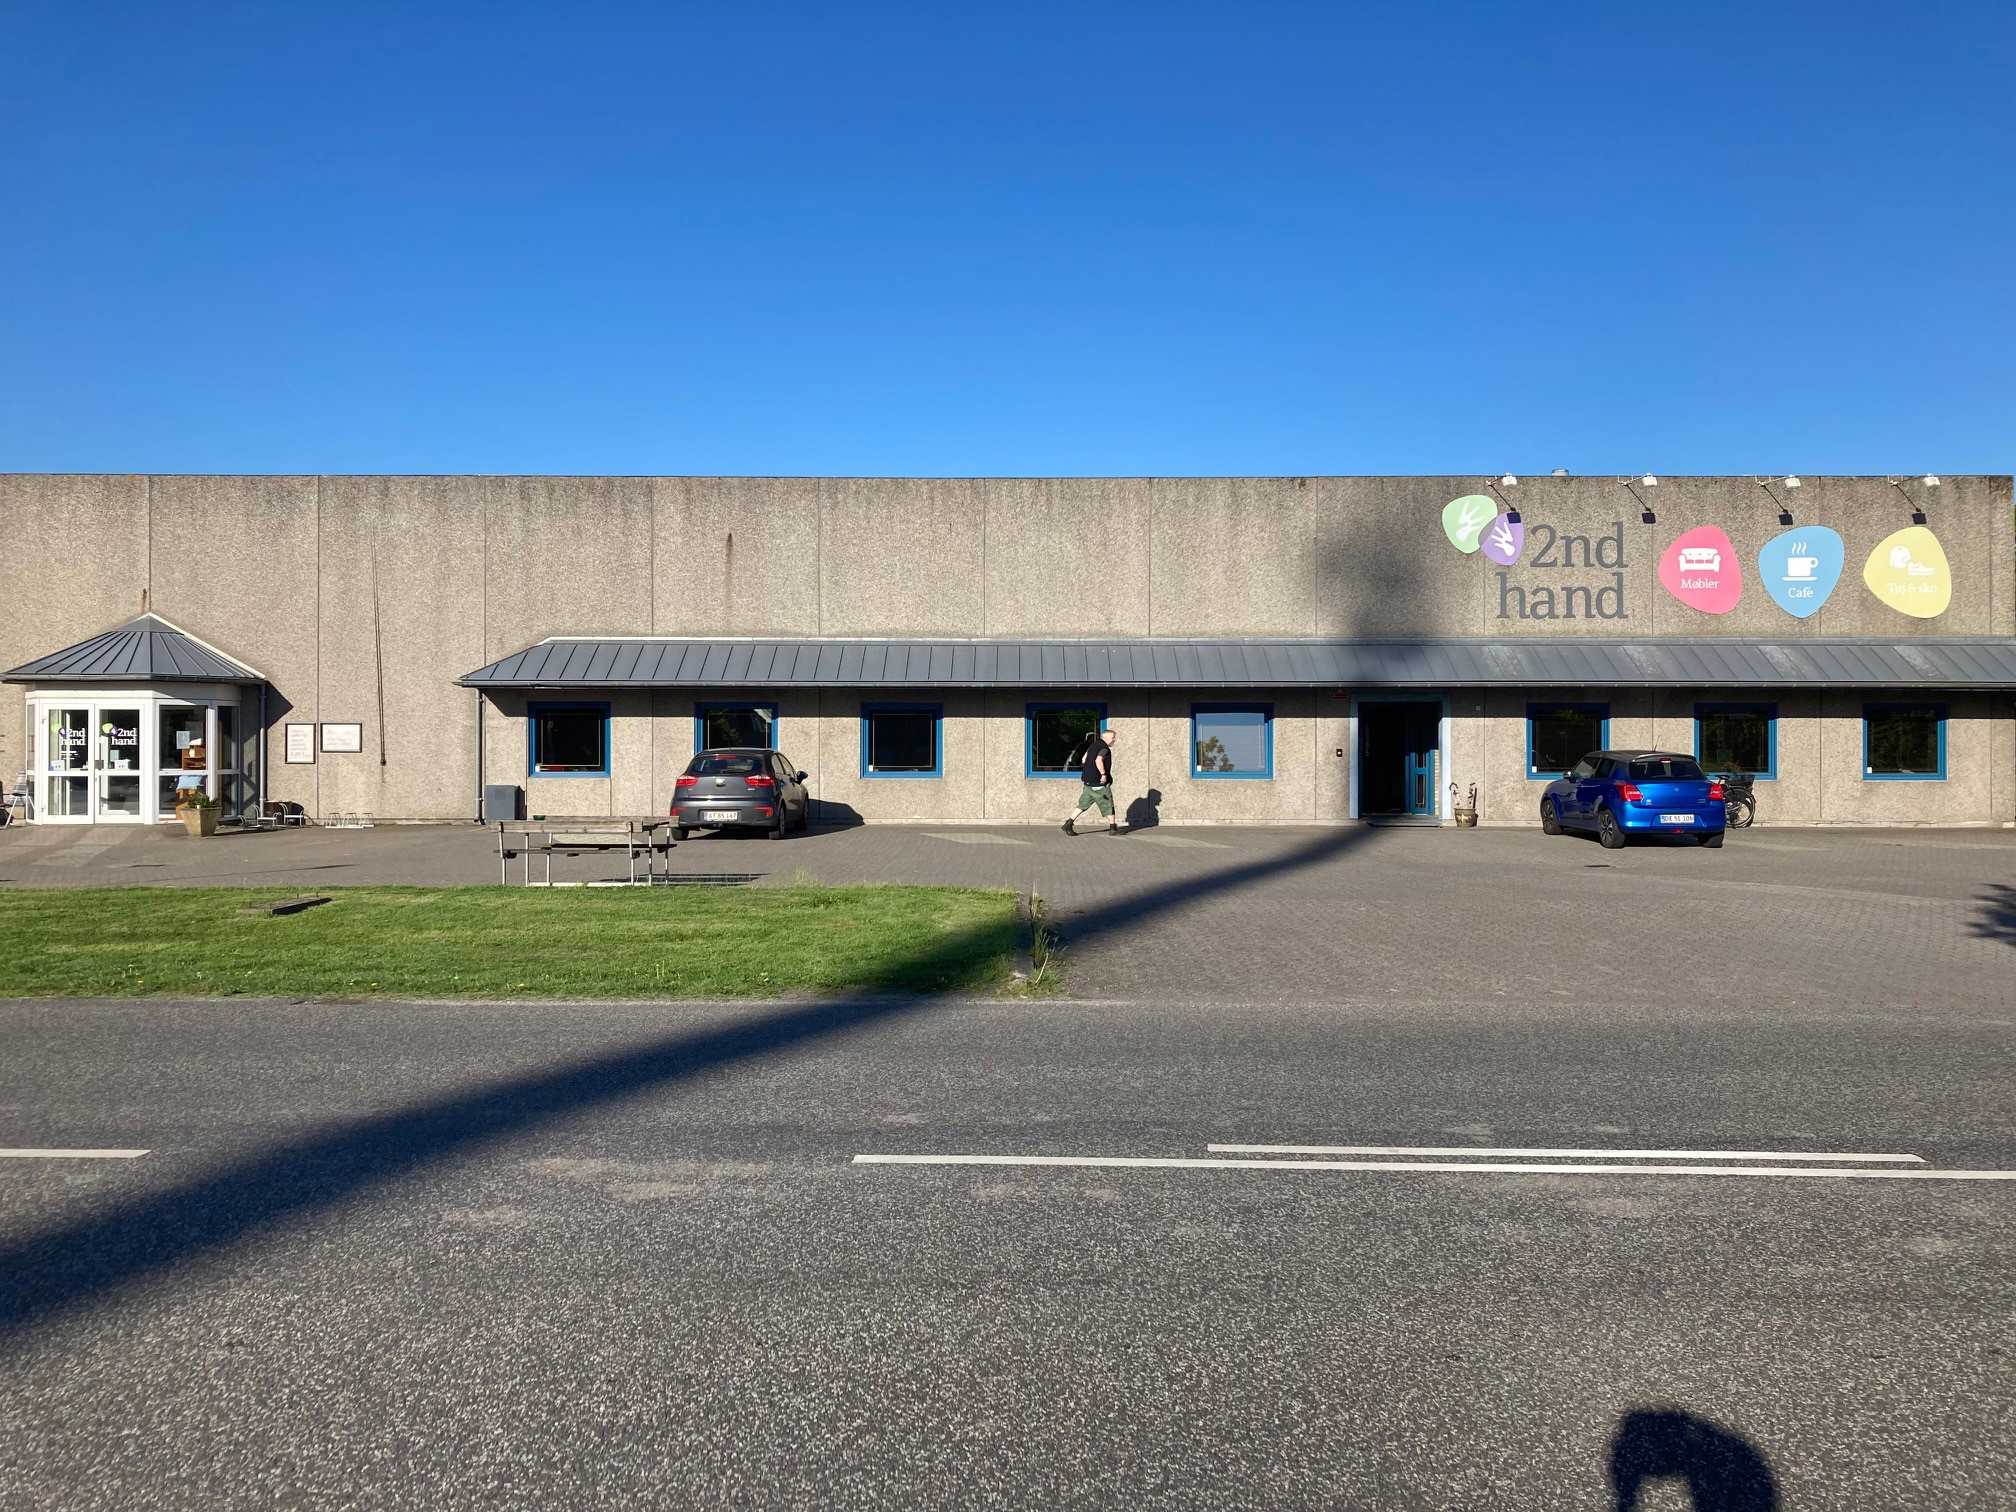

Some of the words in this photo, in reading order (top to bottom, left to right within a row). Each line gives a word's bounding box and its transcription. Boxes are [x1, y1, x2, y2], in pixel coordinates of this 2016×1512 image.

[1529, 521, 1628, 568] 2nd
[1681, 578, 1719, 590] Møbler
[1495, 571, 1628, 619] hand
[1788, 586, 1815, 599] Café
[117, 727, 137, 737] 2nd
[111, 736, 137, 746] hand
